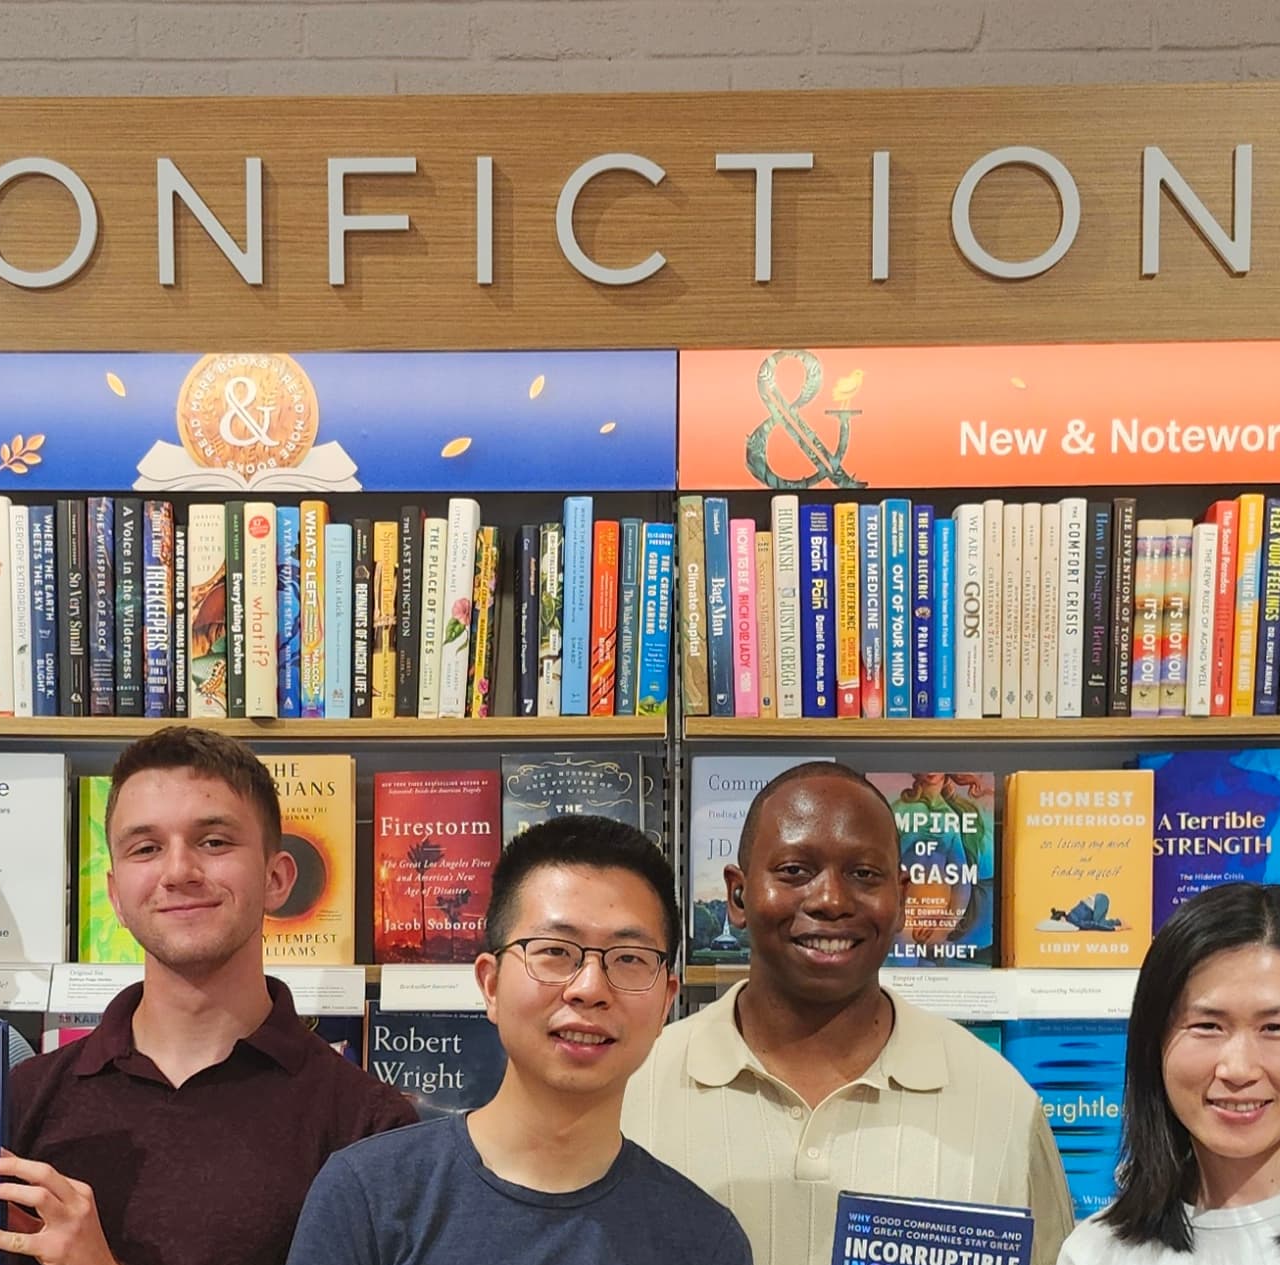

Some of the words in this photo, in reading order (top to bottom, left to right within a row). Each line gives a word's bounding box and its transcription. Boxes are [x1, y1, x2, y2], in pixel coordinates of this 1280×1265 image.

[217, 355, 270, 374] BOOKS
[191, 372, 215, 412] MORE
[281, 373, 304, 414] READ
[220, 376, 280, 446] &
[191, 419, 215, 457] READ
[280, 420, 305, 459] MORE
[959, 420, 1047, 456] New
[1060, 418, 1096, 455] &
[226, 457, 277, 474] BOOKS
[1039, 791, 1133, 807] HONEST
[380, 816, 491, 837] Firestorm
[1026, 814, 1145, 826] MOTHERHOOD
[1158, 813, 1172, 830] A
[1175, 810, 1265, 830] Terrible
[1152, 837, 1272, 856] STRENGTH
[383, 860, 396, 868] The
[399, 860, 421, 868] Great
[424, 860, 437, 868] Los
[440, 860, 469, 870] Angeles
[471, 859, 491, 868] Fires
[1039, 942, 1077, 954] LIBBY
[1082, 942, 1129, 954] WARD
[374, 1026, 461, 1053] Robert
[373, 1061, 465, 1093] Wright
[848, 1212, 870, 1223] WHY
[872, 1215, 901, 1227] GOOD
[903, 1218, 957, 1233] COMPANIES
[959, 1224, 973, 1236] GO
[847, 1223, 871, 1234] HOW
[873, 1226, 903, 1238] GREAT
[906, 1230, 962, 1246] COMPANIES
[964, 1236, 987, 1248] STAY
[989, 1239, 1021, 1252] GREAT
